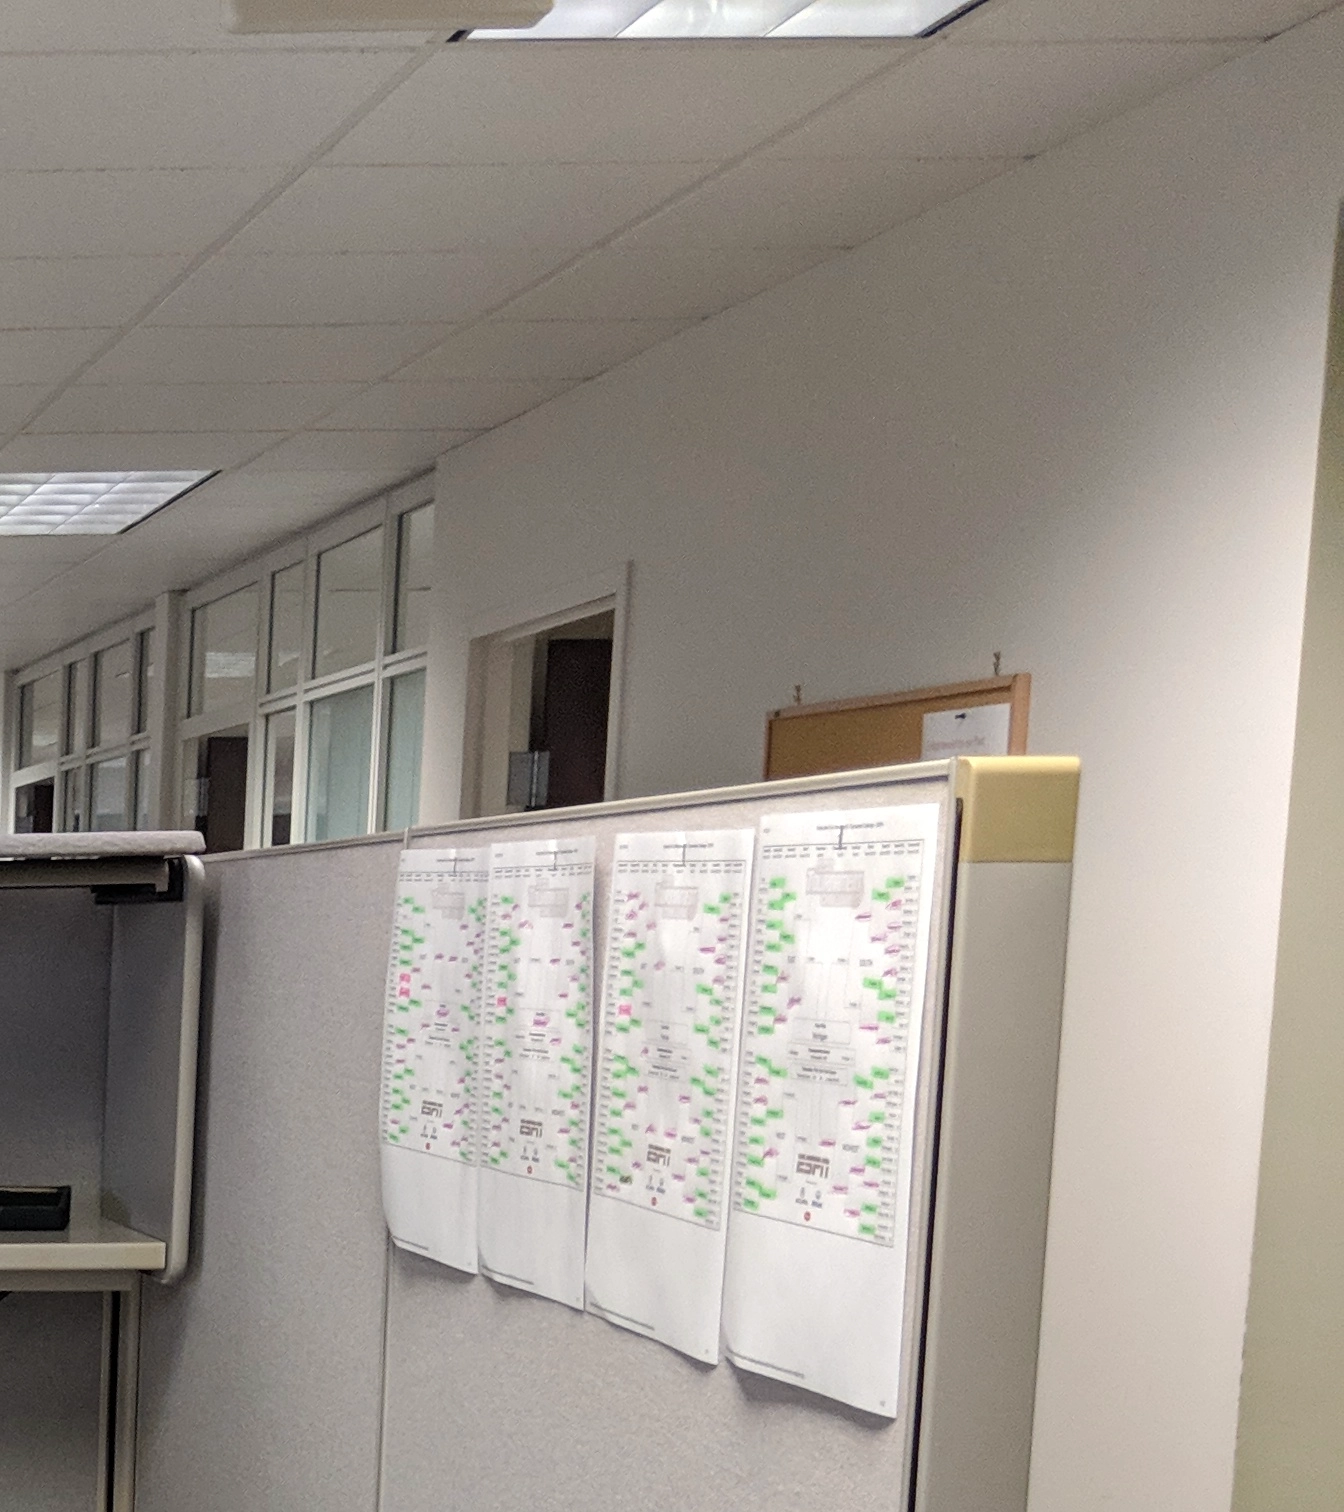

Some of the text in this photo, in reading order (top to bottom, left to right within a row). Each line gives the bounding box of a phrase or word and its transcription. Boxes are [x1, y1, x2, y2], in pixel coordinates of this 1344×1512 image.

[421, 1100, 443, 1118] ESPN
[519, 1119, 543, 1138] ESPN
[646, 1144, 671, 1167] ESPN
[796, 1153, 830, 1179] ESPN
